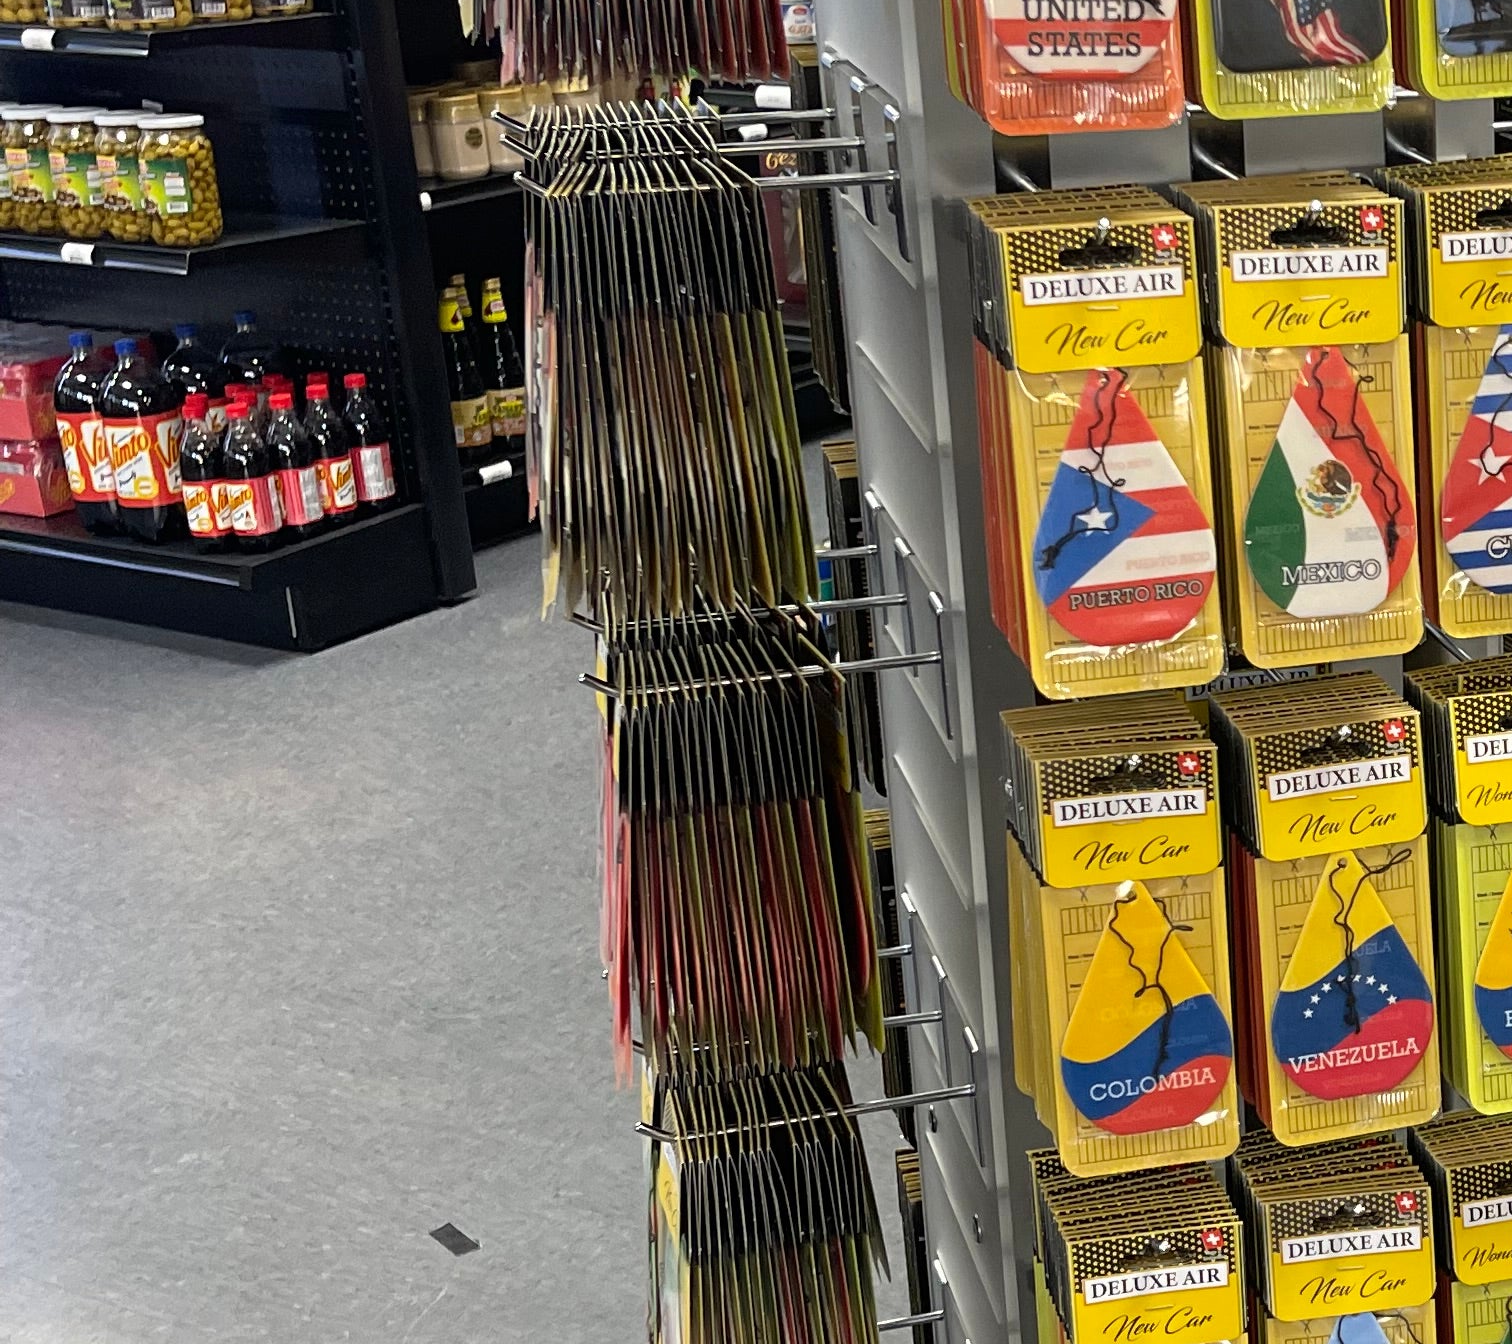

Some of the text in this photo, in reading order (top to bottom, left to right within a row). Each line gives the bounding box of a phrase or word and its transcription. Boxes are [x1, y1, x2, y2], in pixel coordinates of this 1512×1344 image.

[1027, 31, 1142, 57] STATES
[1239, 252, 1381, 277] DELUXE AIR
[1029, 273, 1177, 301] DELUXE AIR
[1253, 295, 1372, 332] New Car
[1044, 323, 1168, 356] New Car
[1281, 559, 1382, 586] MEXICO
[1068, 579, 1203, 611] PUERTO RICO
[1275, 763, 1404, 797] DELUXE AIR
[1059, 793, 1199, 823] DELUXE AIR
[1289, 808, 1398, 842] New Car
[1074, 838, 1192, 870] New Car
[1288, 1037, 1420, 1075] VENEZUELA
[1089, 1067, 1215, 1102] COLOMBIA
[1288, 1230, 1416, 1261] DELUXE AIR
[1090, 1266, 1224, 1300] DELUXE AIR
[1300, 1274, 1408, 1304] New Car
[1103, 1310, 1213, 1342] New Car
